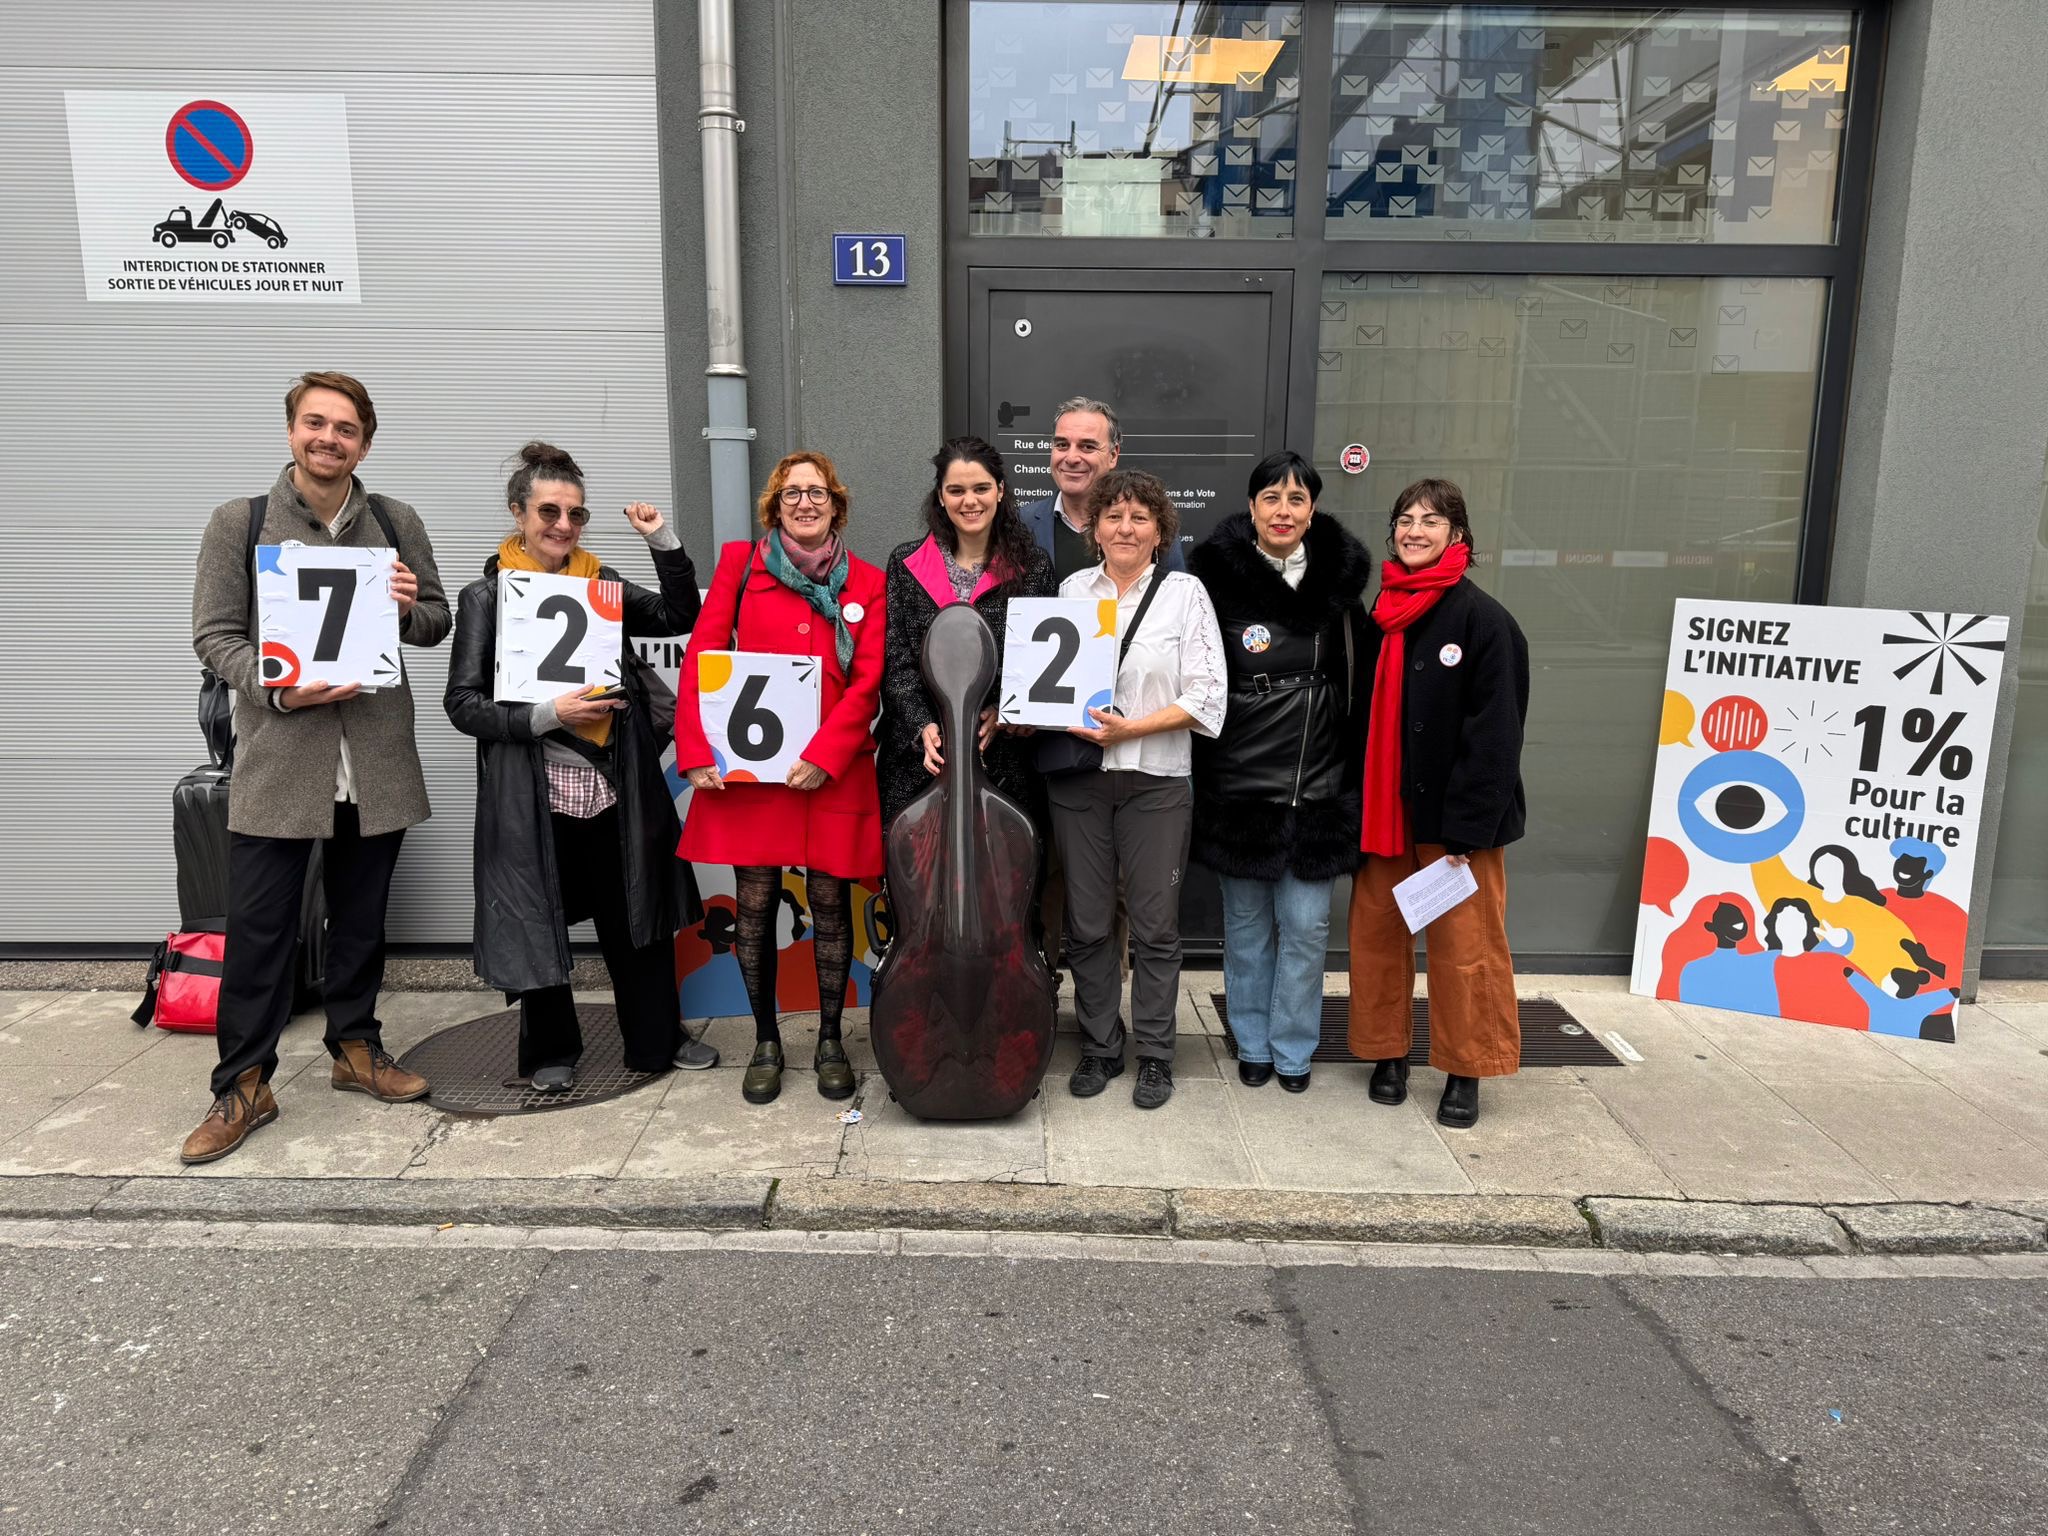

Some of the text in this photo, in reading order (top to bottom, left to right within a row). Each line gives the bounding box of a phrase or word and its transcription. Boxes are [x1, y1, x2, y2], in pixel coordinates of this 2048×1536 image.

[123, 259, 326, 274] INTERDICTION DE STATIONNER
[849, 241, 890, 276] 13
[108, 276, 344, 292] SORTIE DE VÉHICULES JOUR ET NUIT
[1014, 439, 1035, 449] Rue
[1014, 488, 1054, 497] Direction
[1183, 489, 1194, 498] de
[1196, 489, 1216, 498] Vote
[297, 568, 357, 662] 7
[1687, 616, 1792, 646] SIGNEZ
[536, 594, 588, 684] 2
[1028, 616, 1081, 704] 2
[1684, 649, 1862, 685] L'INITIATIVE
[727, 675, 784, 761] 6
[1854, 705, 1973, 780] 1%
[1849, 778, 1965, 816] Pour la
[1845, 813, 1960, 848] culture
